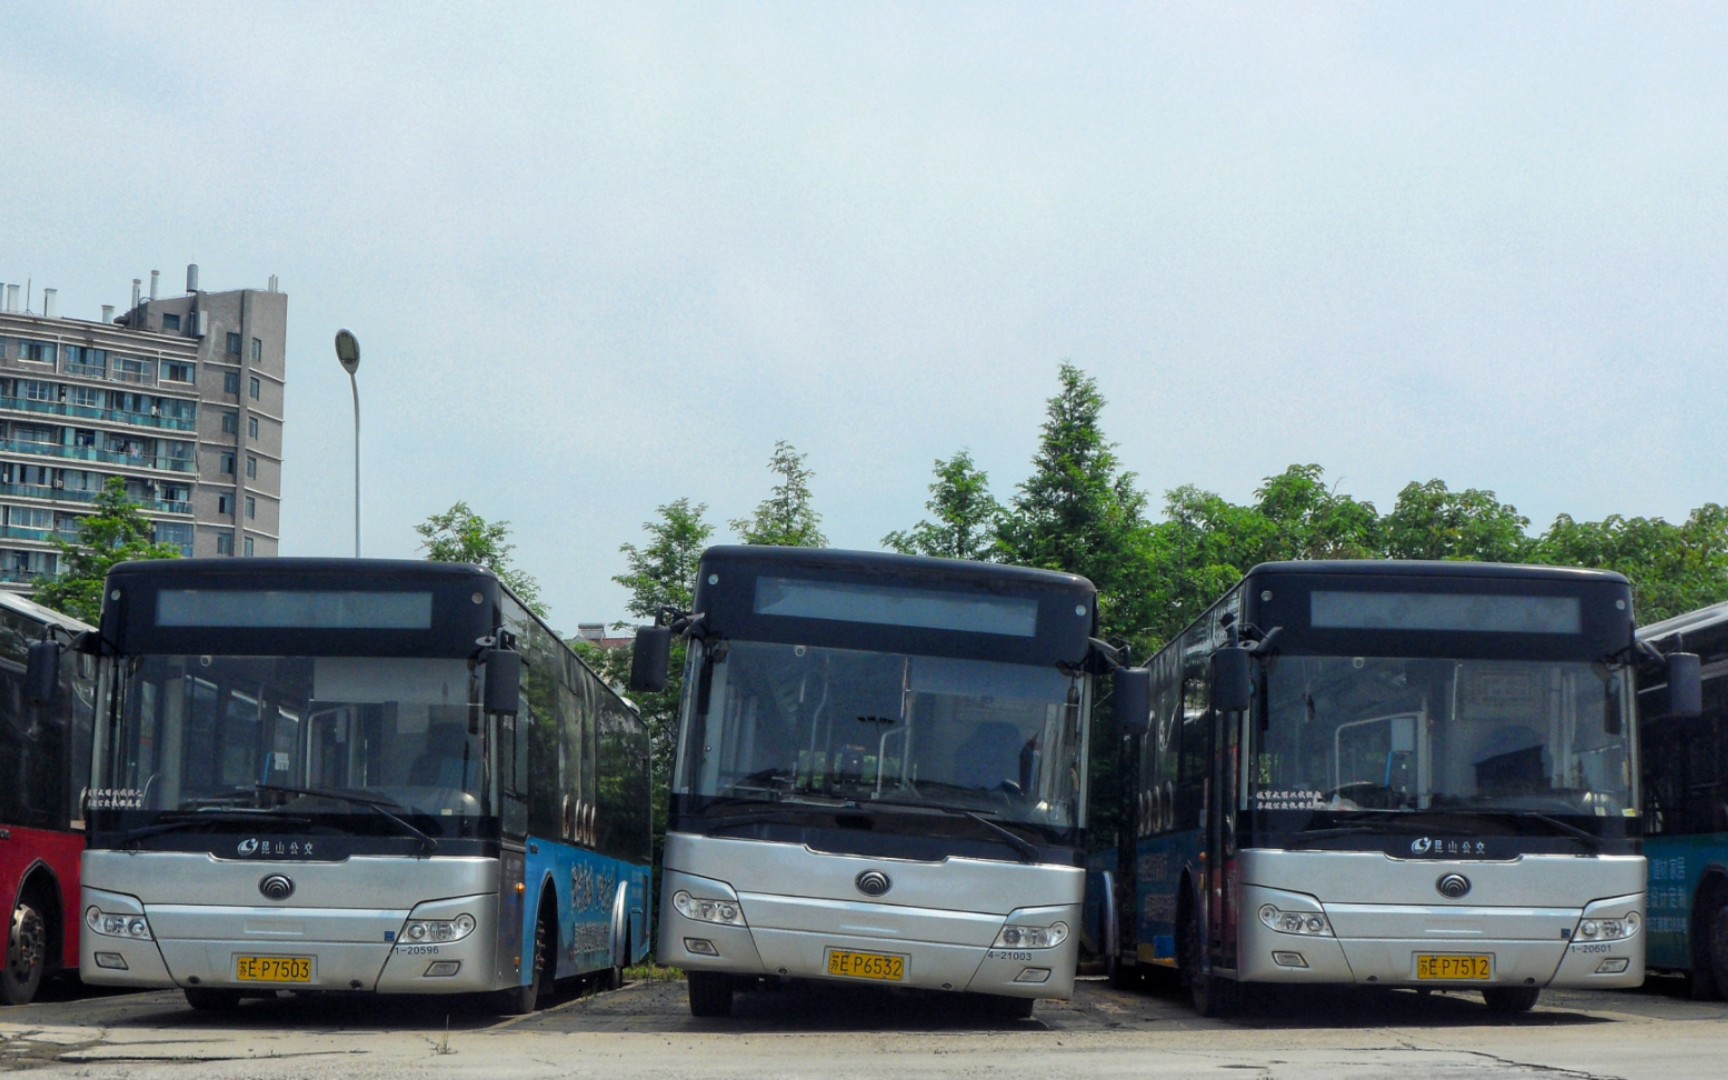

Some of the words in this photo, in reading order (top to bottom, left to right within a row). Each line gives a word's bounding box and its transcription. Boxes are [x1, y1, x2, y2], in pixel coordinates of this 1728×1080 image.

[261, 840, 313, 855] 昆山公交
[1434, 839, 1485, 855] 昆山公交
[395, 945, 440, 955] 1-20596
[987, 950, 1033, 961] 4-21003
